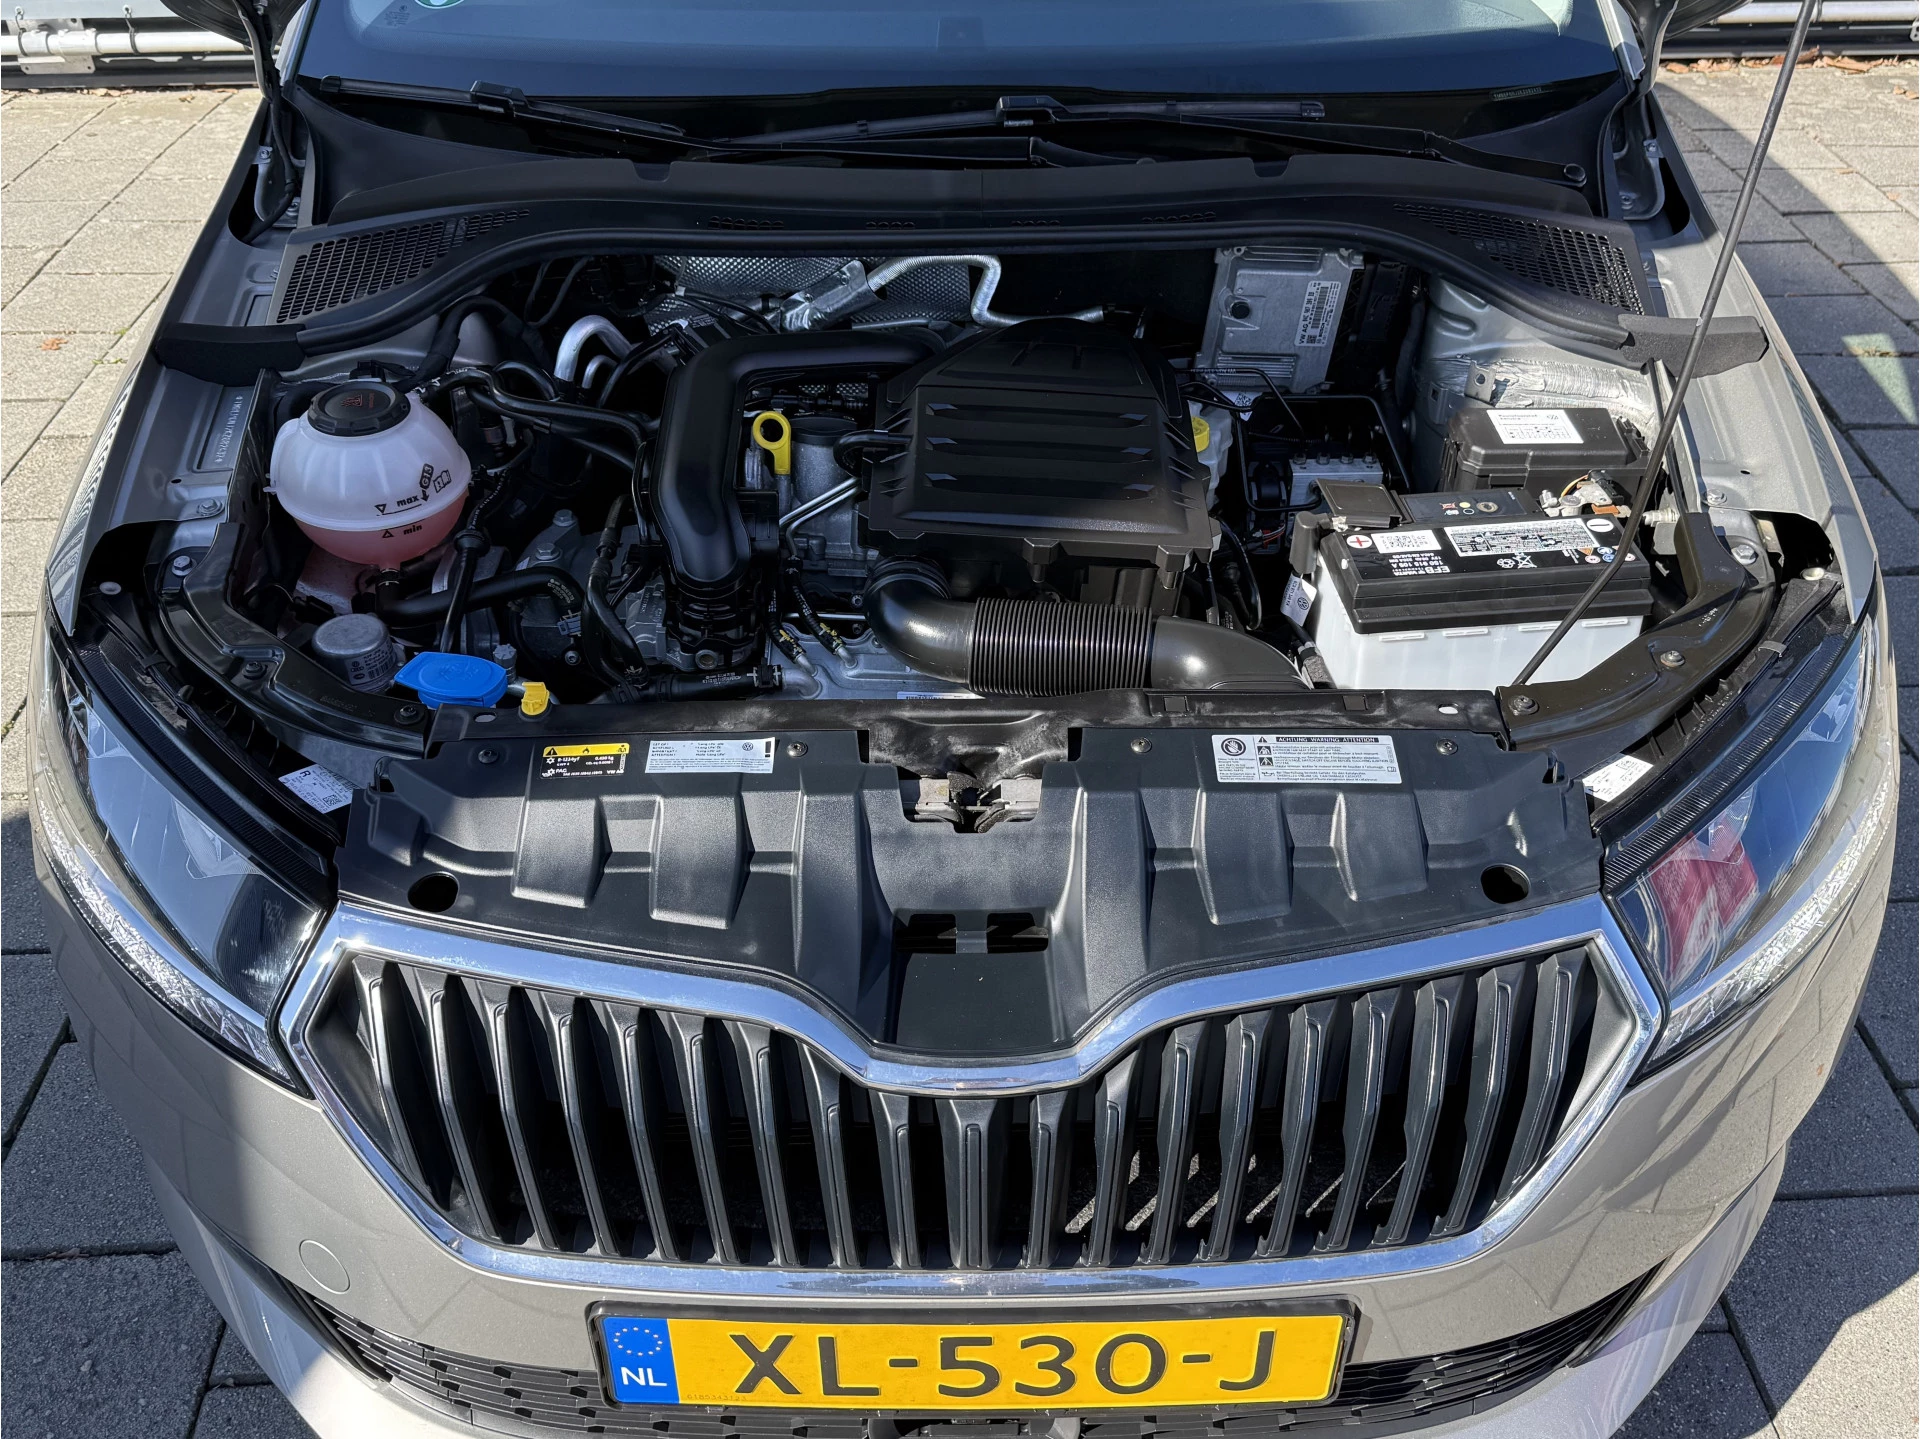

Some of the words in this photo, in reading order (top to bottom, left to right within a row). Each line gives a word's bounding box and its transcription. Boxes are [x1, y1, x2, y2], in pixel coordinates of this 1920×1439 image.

[397, 495, 420, 507] max
[403, 525, 423, 535] min
[729, 1331, 1276, 1397] XL-530-J
[621, 1366, 667, 1388] NL
